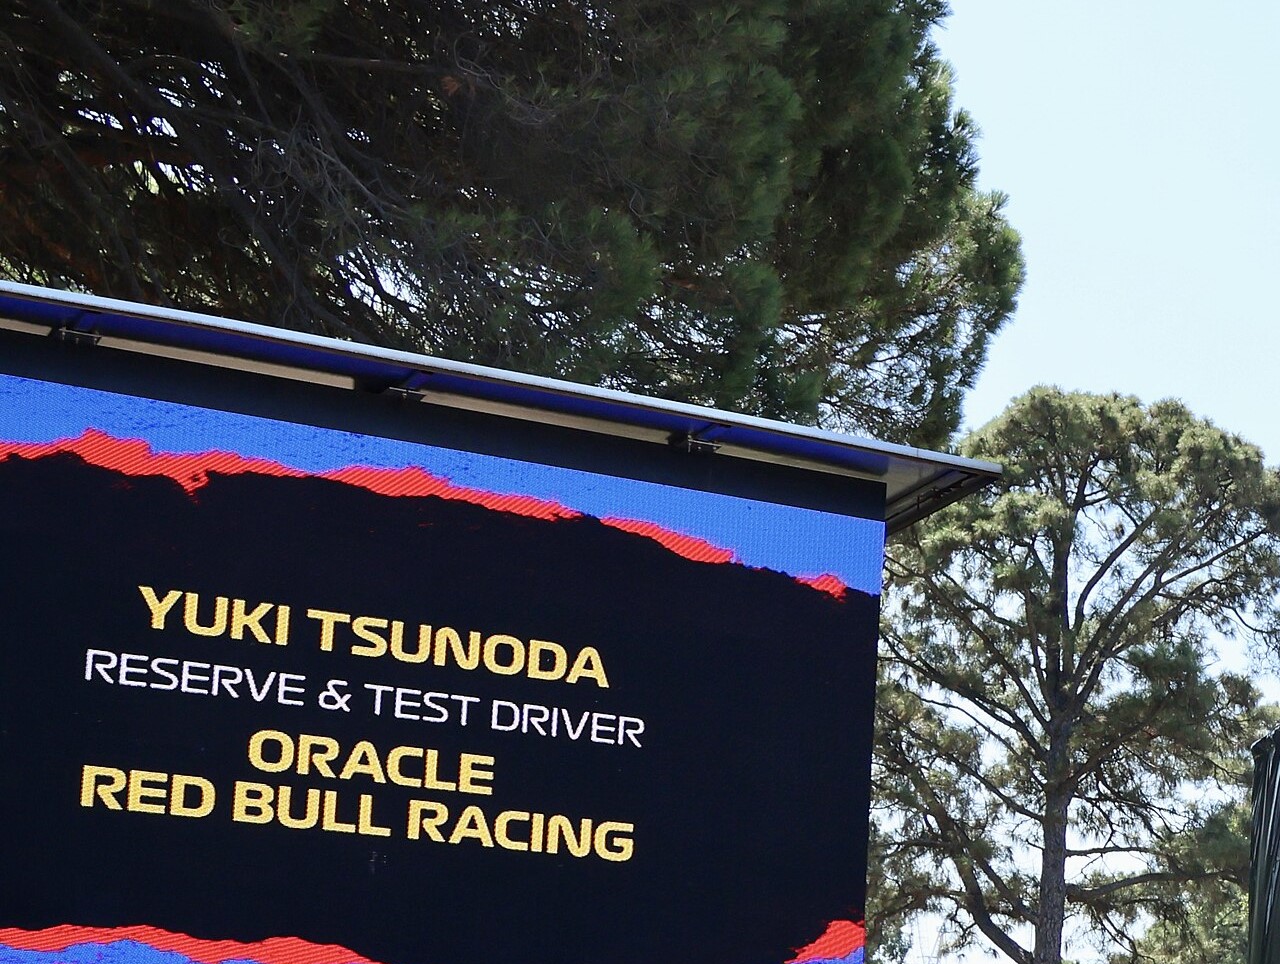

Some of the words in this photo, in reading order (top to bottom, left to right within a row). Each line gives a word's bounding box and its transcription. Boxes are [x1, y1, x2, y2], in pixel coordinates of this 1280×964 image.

[138, 585, 291, 646] YUKI
[306, 608, 610, 689] TSUNODA
[84, 648, 307, 707] RESERVE
[318, 679, 352, 713] &
[363, 683, 481, 727] TEST
[490, 699, 645, 748] DRIVER
[247, 729, 495, 796] ORACLE
[79, 764, 216, 818] RED
[232, 780, 392, 837] BULL
[407, 799, 635, 862] RACING
